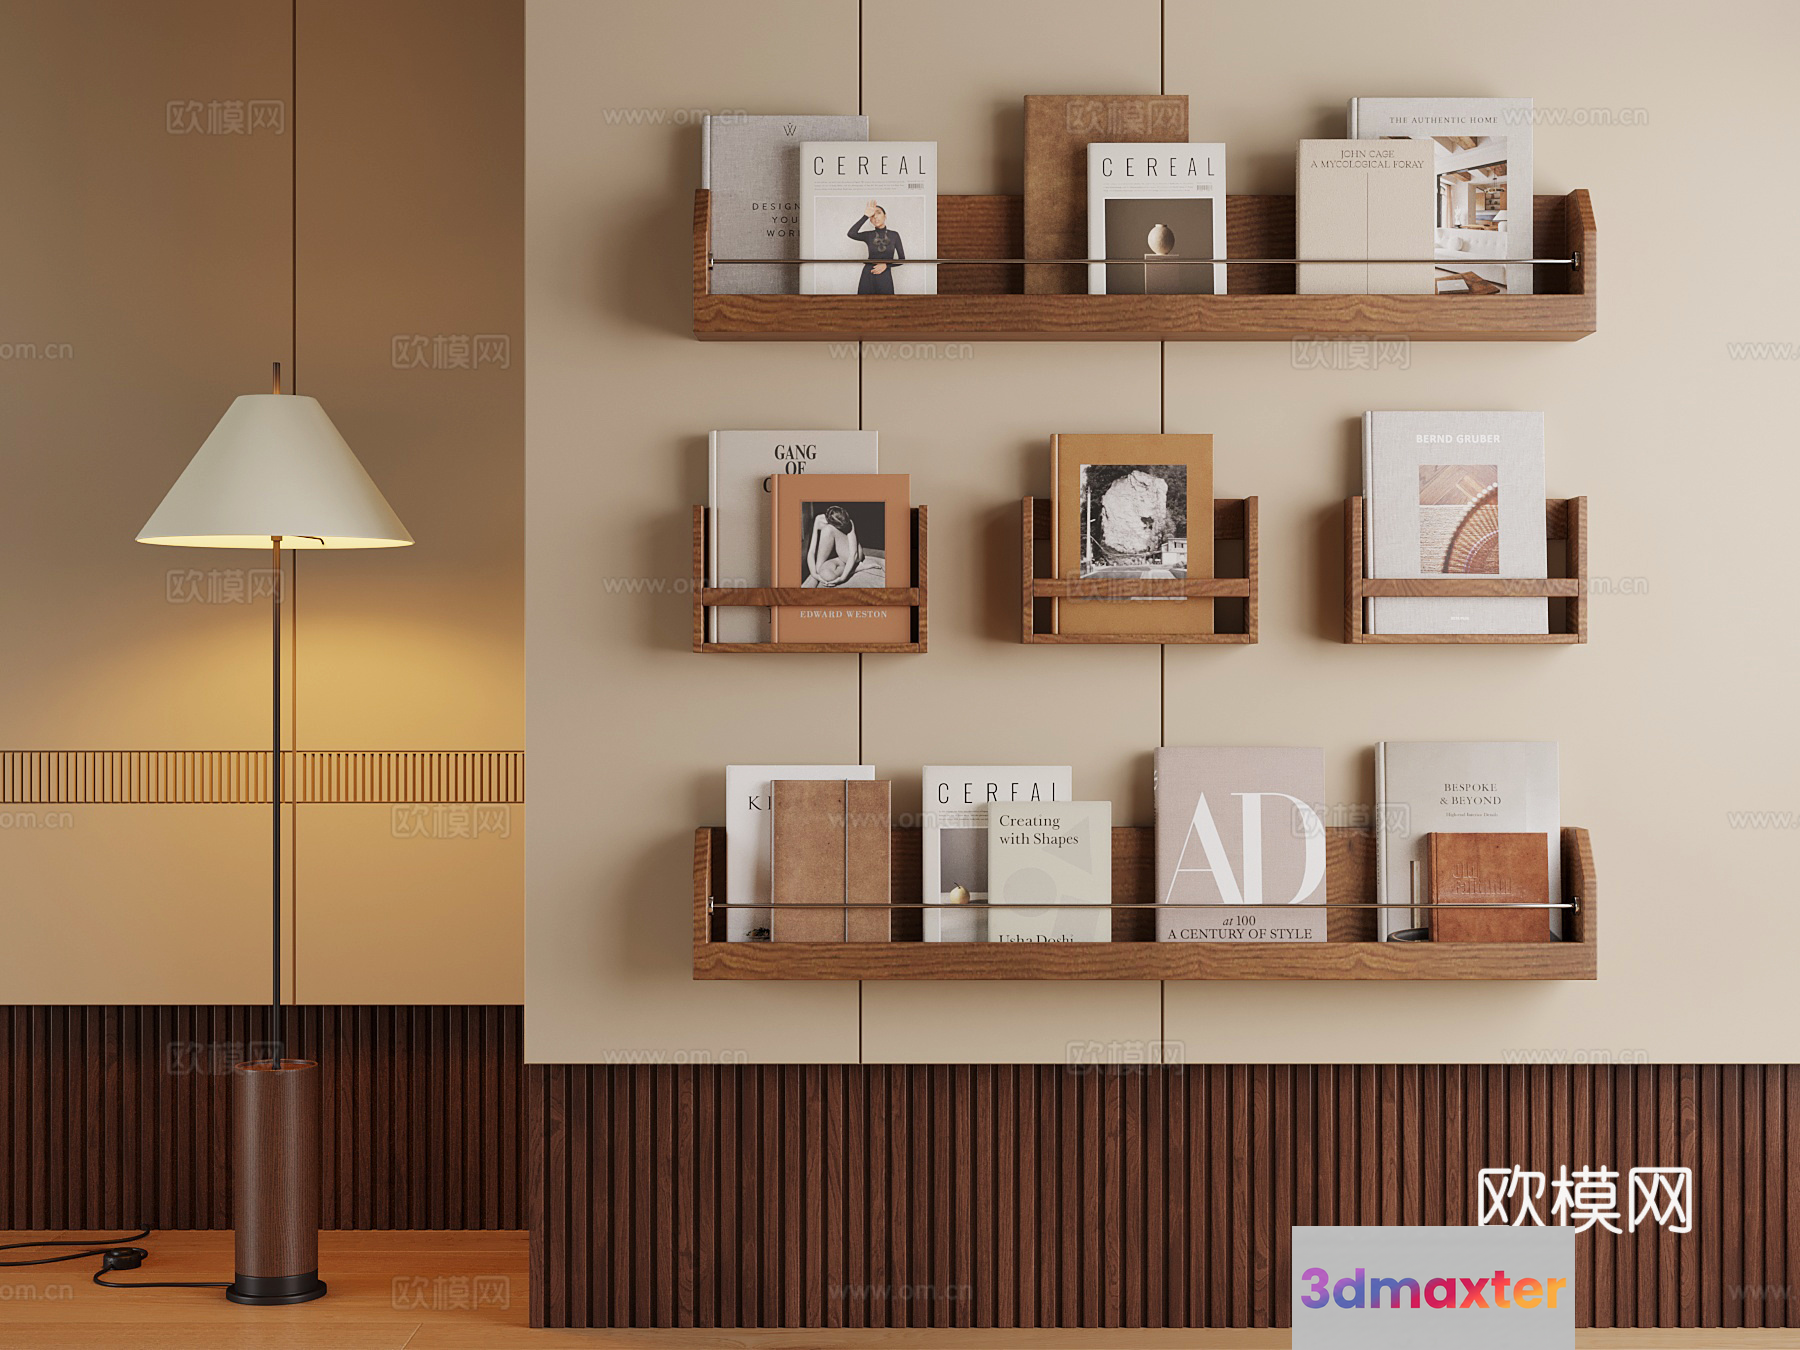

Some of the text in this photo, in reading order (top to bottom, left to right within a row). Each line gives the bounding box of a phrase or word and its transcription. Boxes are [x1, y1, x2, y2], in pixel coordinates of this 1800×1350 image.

[1389, 116, 1498, 124] THE AUTHENTIC HOME
[1341, 150, 1395, 159] JOHN CAGE
[813, 155, 926, 175] CEREAL
[1102, 157, 1215, 177] CEREAL
[1310, 160, 1424, 169] A MYCOLOGICAL FORAY
[1416, 434, 1500, 443] BERND GRUBER
[774, 444, 817, 460] GANG
[785, 461, 806, 474] OF
[800, 610, 888, 618] EDWARD WESTON
[1444, 783, 1498, 792] BESPOKE
[1440, 796, 1502, 805] & BEYOND
[999, 814, 1060, 830] Creating
[999, 832, 1079, 848] with Shapes
[1163, 791, 1327, 908] AD
[1222, 915, 1256, 926] at 100
[1168, 928, 1312, 940] A CENTURY OF STYLE
